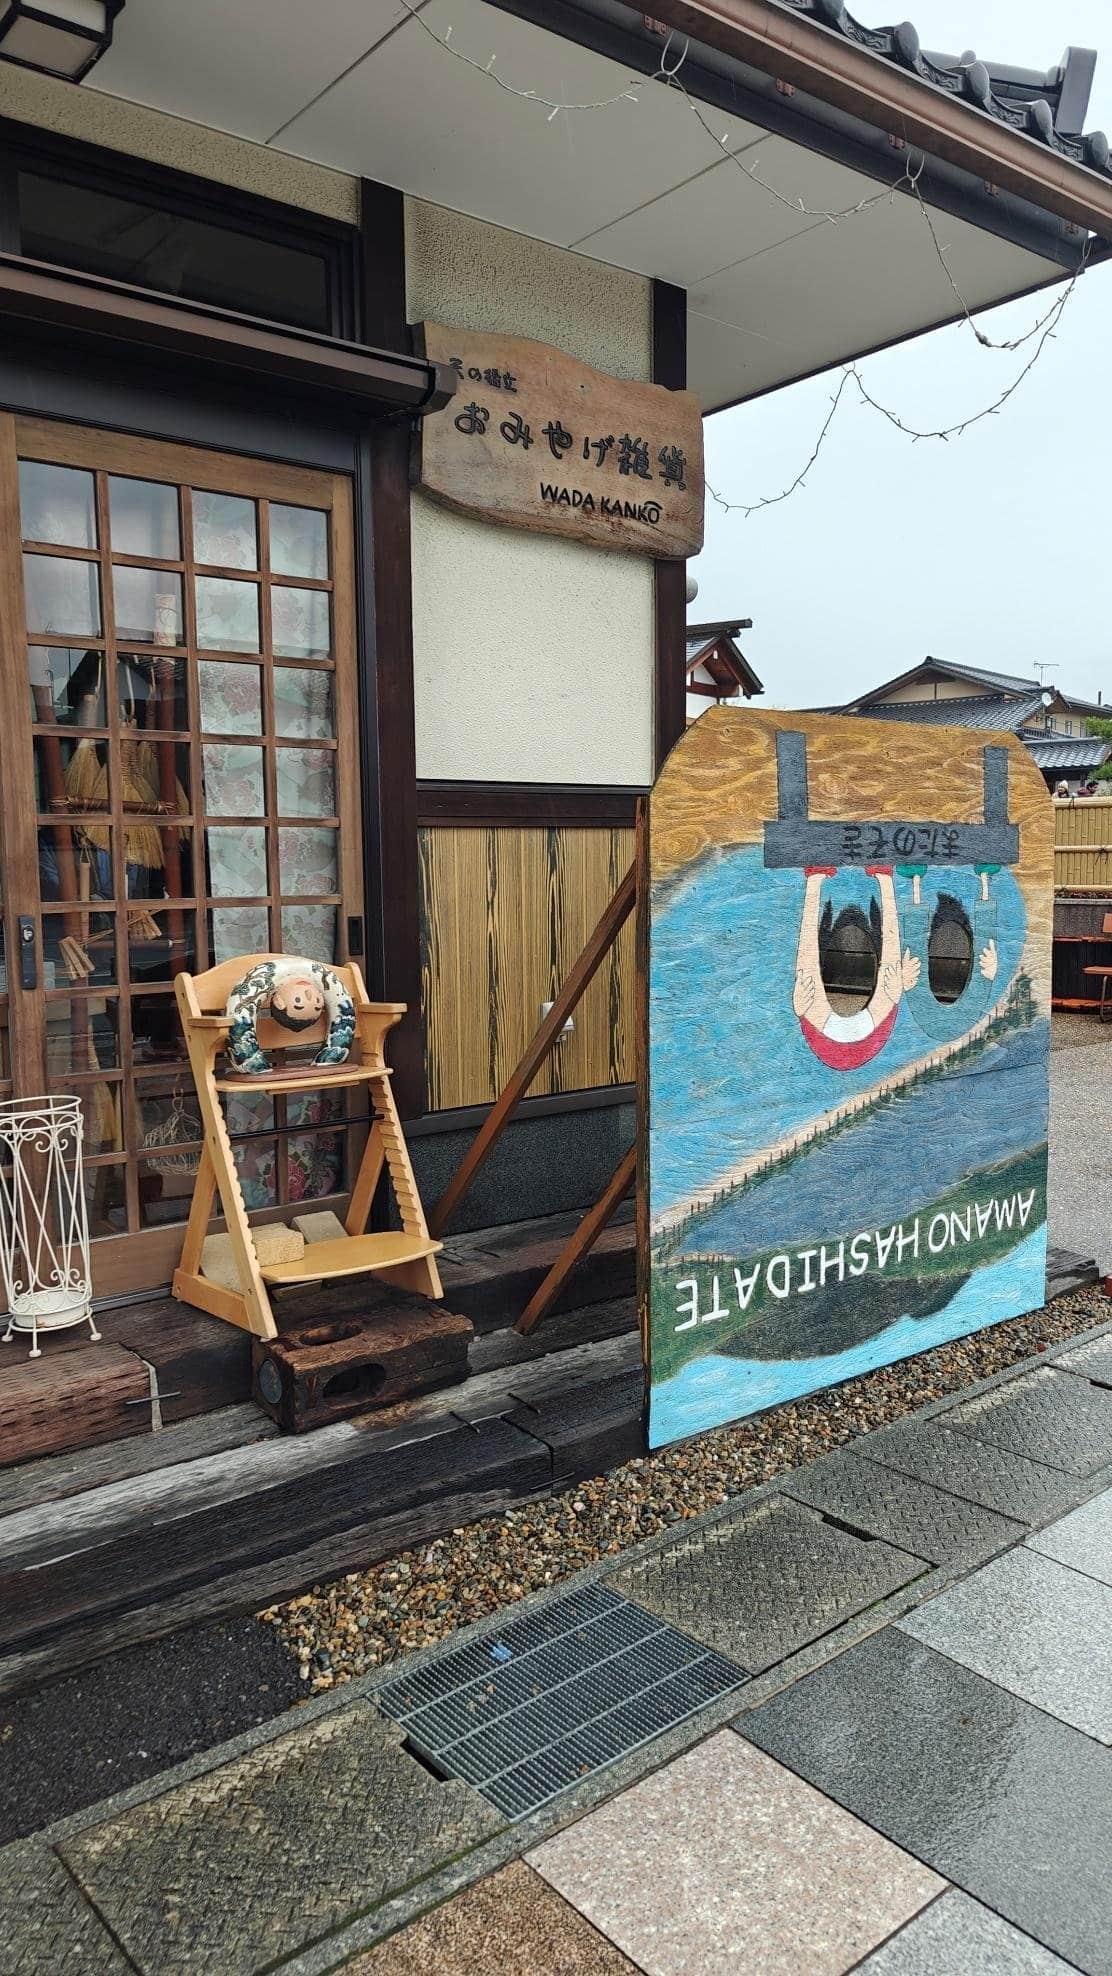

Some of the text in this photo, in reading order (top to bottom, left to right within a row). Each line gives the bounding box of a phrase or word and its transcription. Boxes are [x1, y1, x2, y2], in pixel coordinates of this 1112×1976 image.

[454, 402, 687, 491] おみやげ雑貨
[540, 482, 596, 511] WADA
[841, 825, 960, 860] またのぞき
